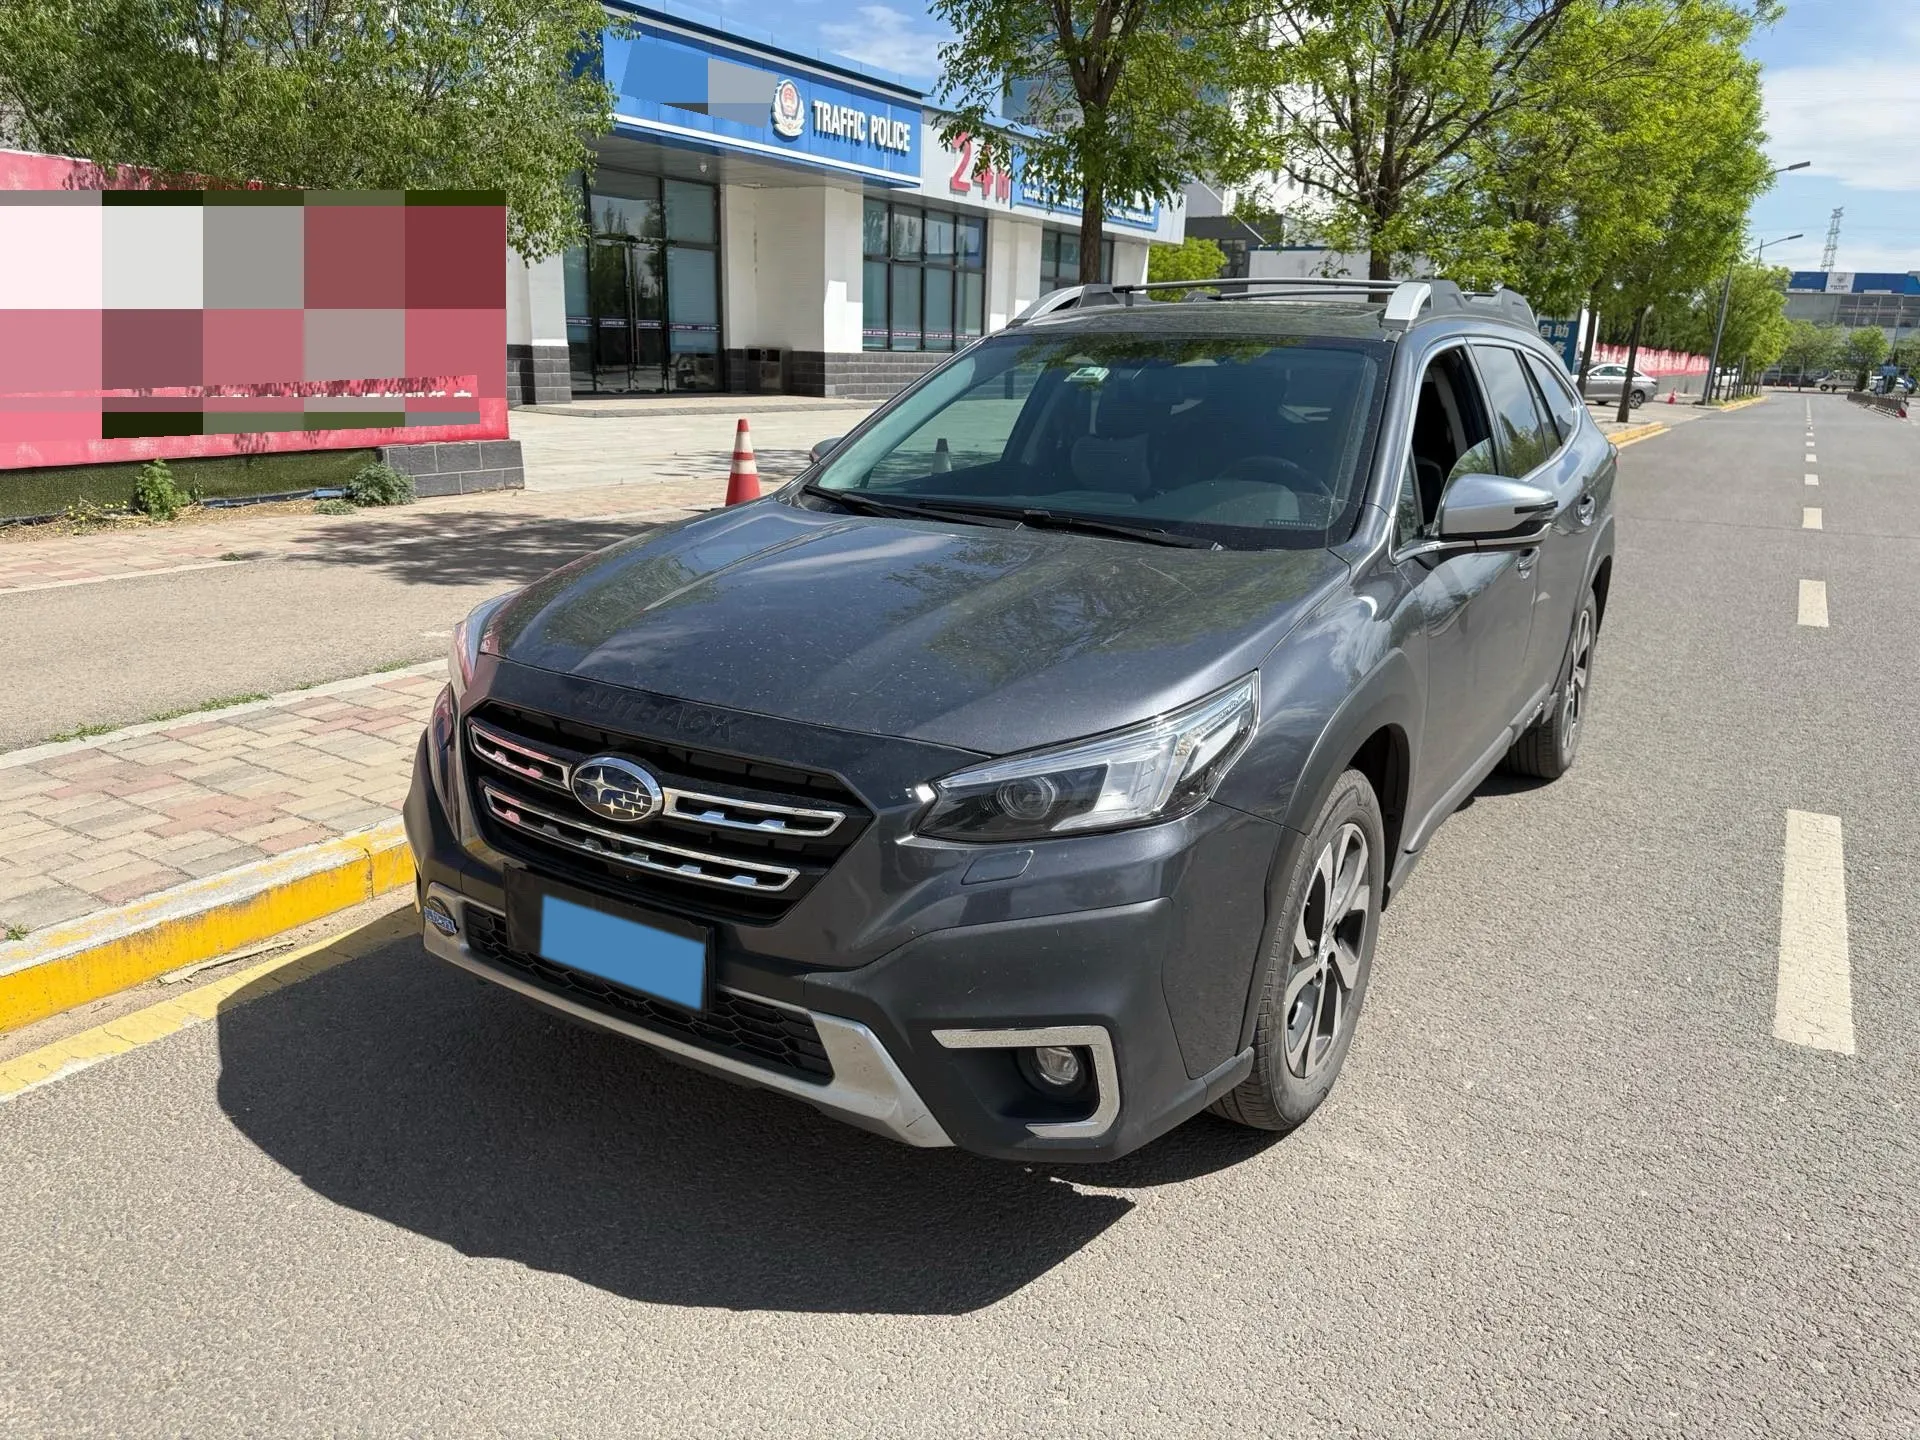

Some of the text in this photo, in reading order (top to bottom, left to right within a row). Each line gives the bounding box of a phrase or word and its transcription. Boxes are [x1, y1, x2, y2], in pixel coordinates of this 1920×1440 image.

[814, 100, 911, 152] TRAFFIC POLICE
[1540, 323, 1569, 338] 自助
